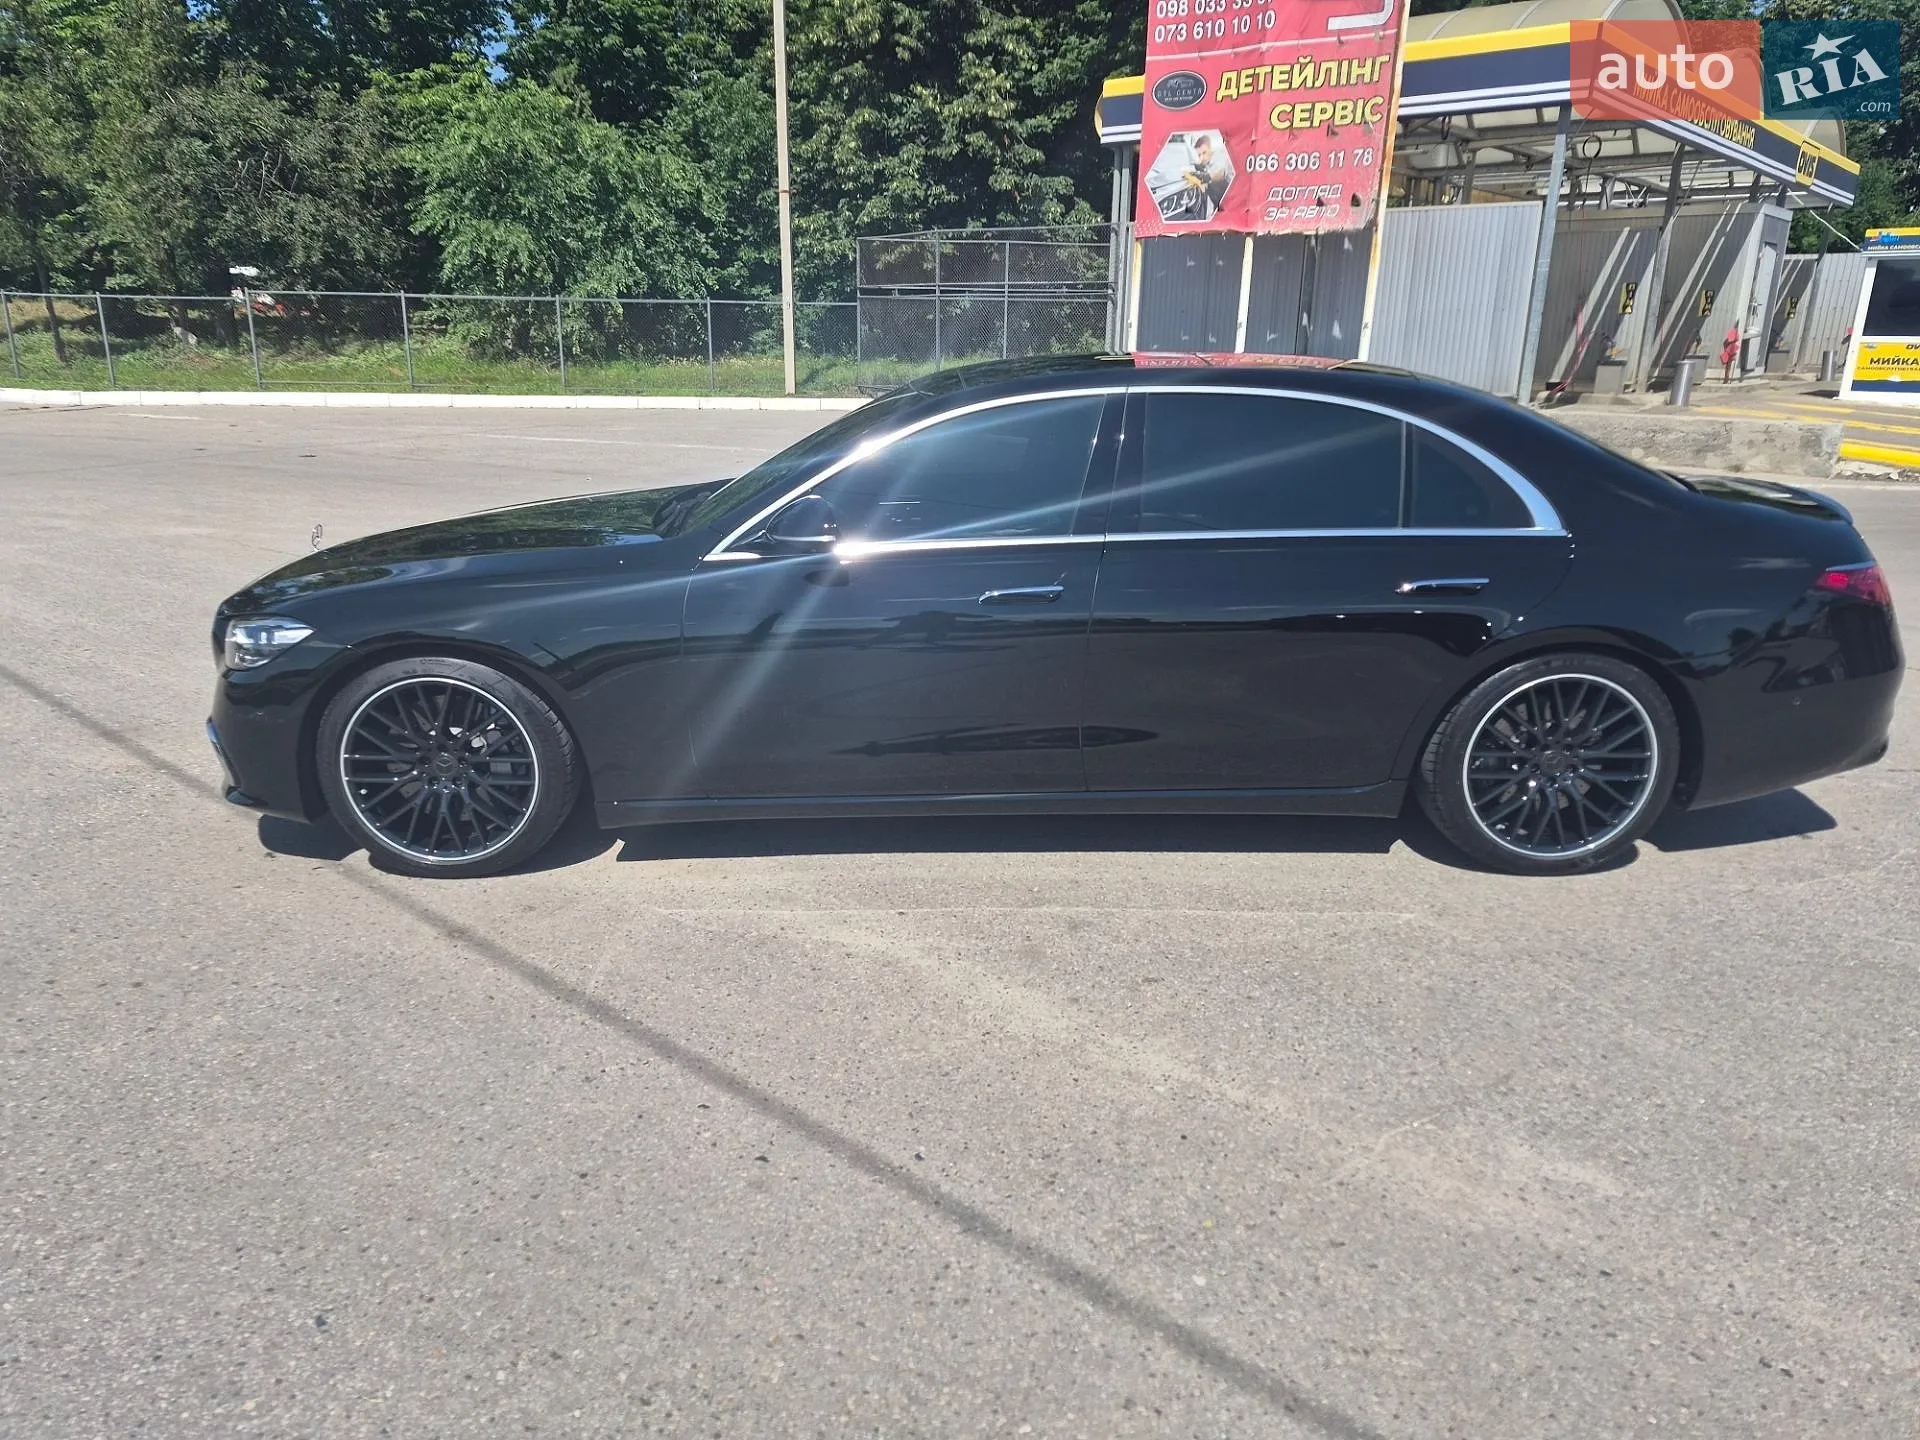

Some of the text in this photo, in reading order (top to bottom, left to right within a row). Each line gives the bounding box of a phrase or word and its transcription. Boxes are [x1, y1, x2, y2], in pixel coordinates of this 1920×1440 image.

[1155, 0, 1188, 18] 098
[1154, 9, 1276, 43] 073 610 10 10
[1216, 55, 1391, 102] ДЕТЕЙЛІНГ
[1270, 96, 1385, 129] СЕРВІС
[1246, 147, 1374, 173] 066 306 11 78
[1266, 184, 1343, 201] ДОГЛЯД
[1869, 355, 1919, 366] МИЙКА
